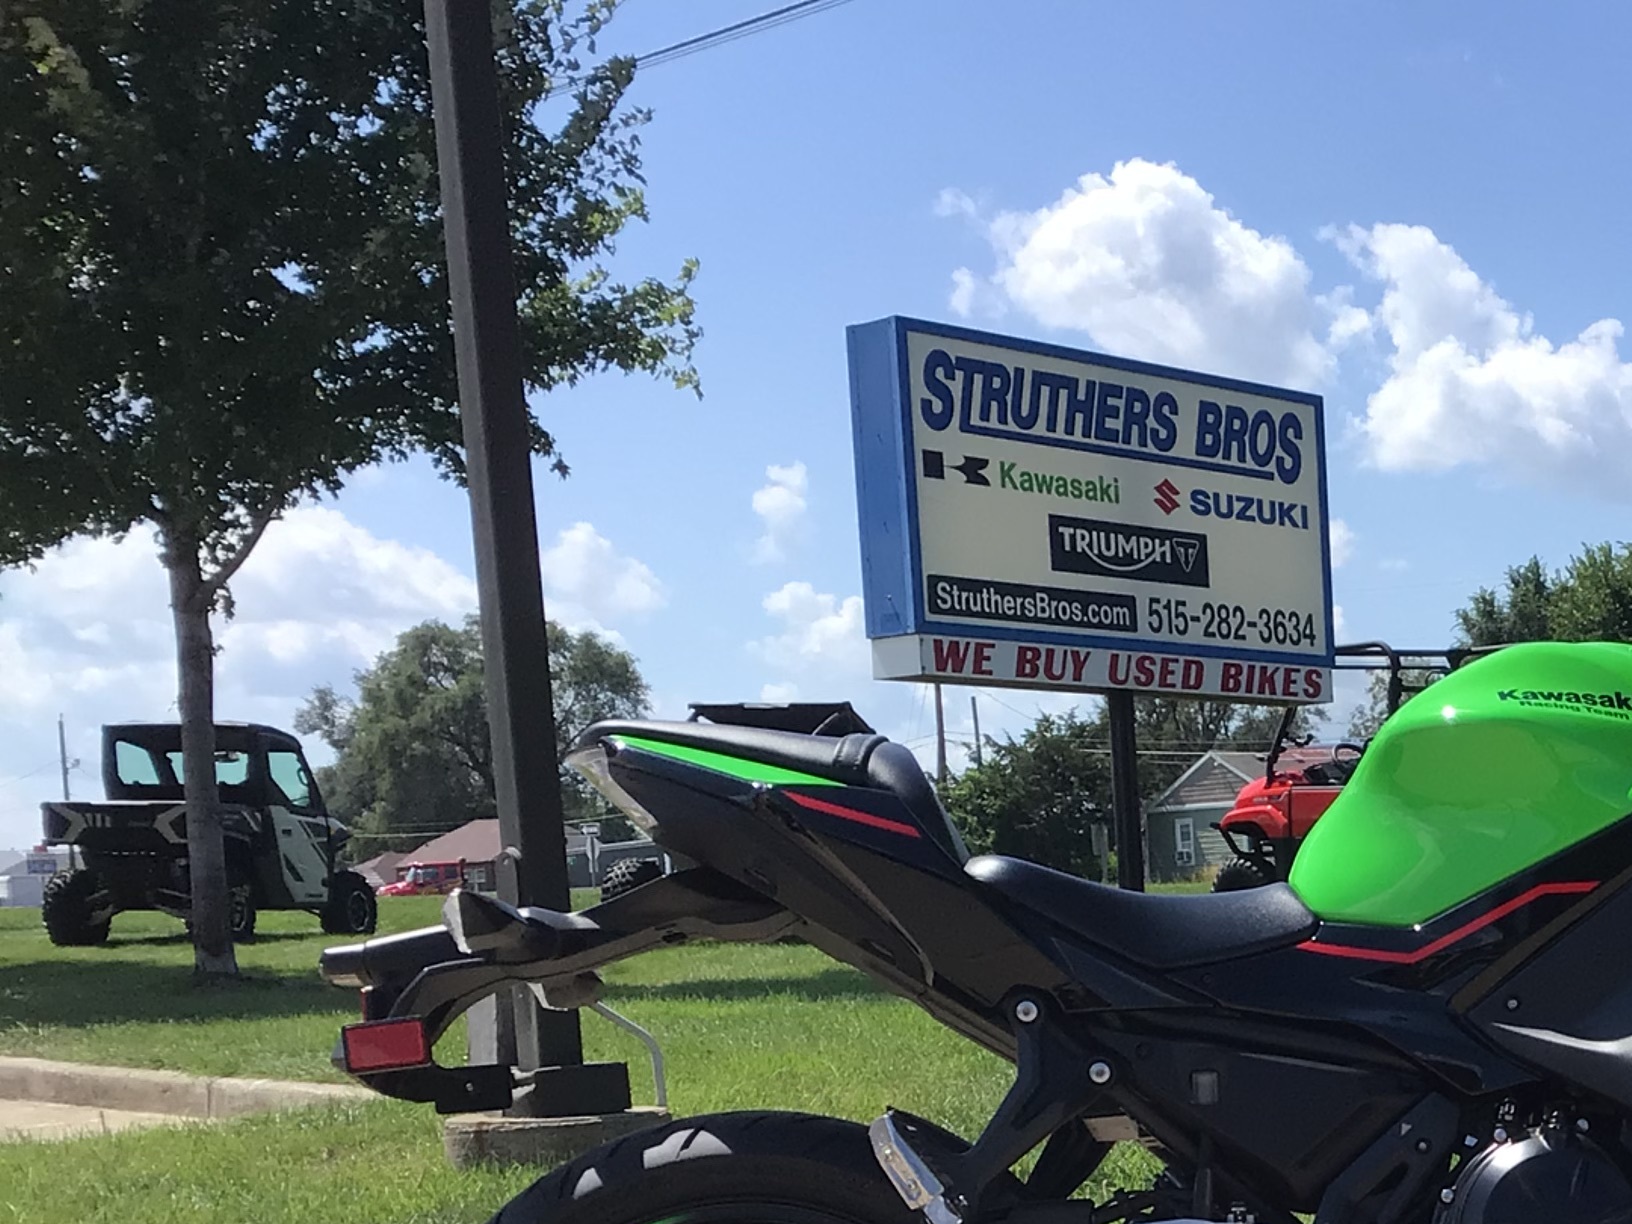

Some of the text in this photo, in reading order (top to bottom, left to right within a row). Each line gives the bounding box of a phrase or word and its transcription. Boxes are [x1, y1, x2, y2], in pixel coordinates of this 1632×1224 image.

[920, 349, 1303, 485] STRUTHERS BROS
[999, 461, 1121, 504] Kawasaki
[1190, 489, 1309, 529] SUZUKI
[1058, 526, 1172, 570] TRIUMPH
[935, 583, 1316, 647] StruthersBros.com 515-282-3634
[933, 639, 1323, 699] WE BUY USED BIKES
[1519, 700, 1630, 720] Racing Team
